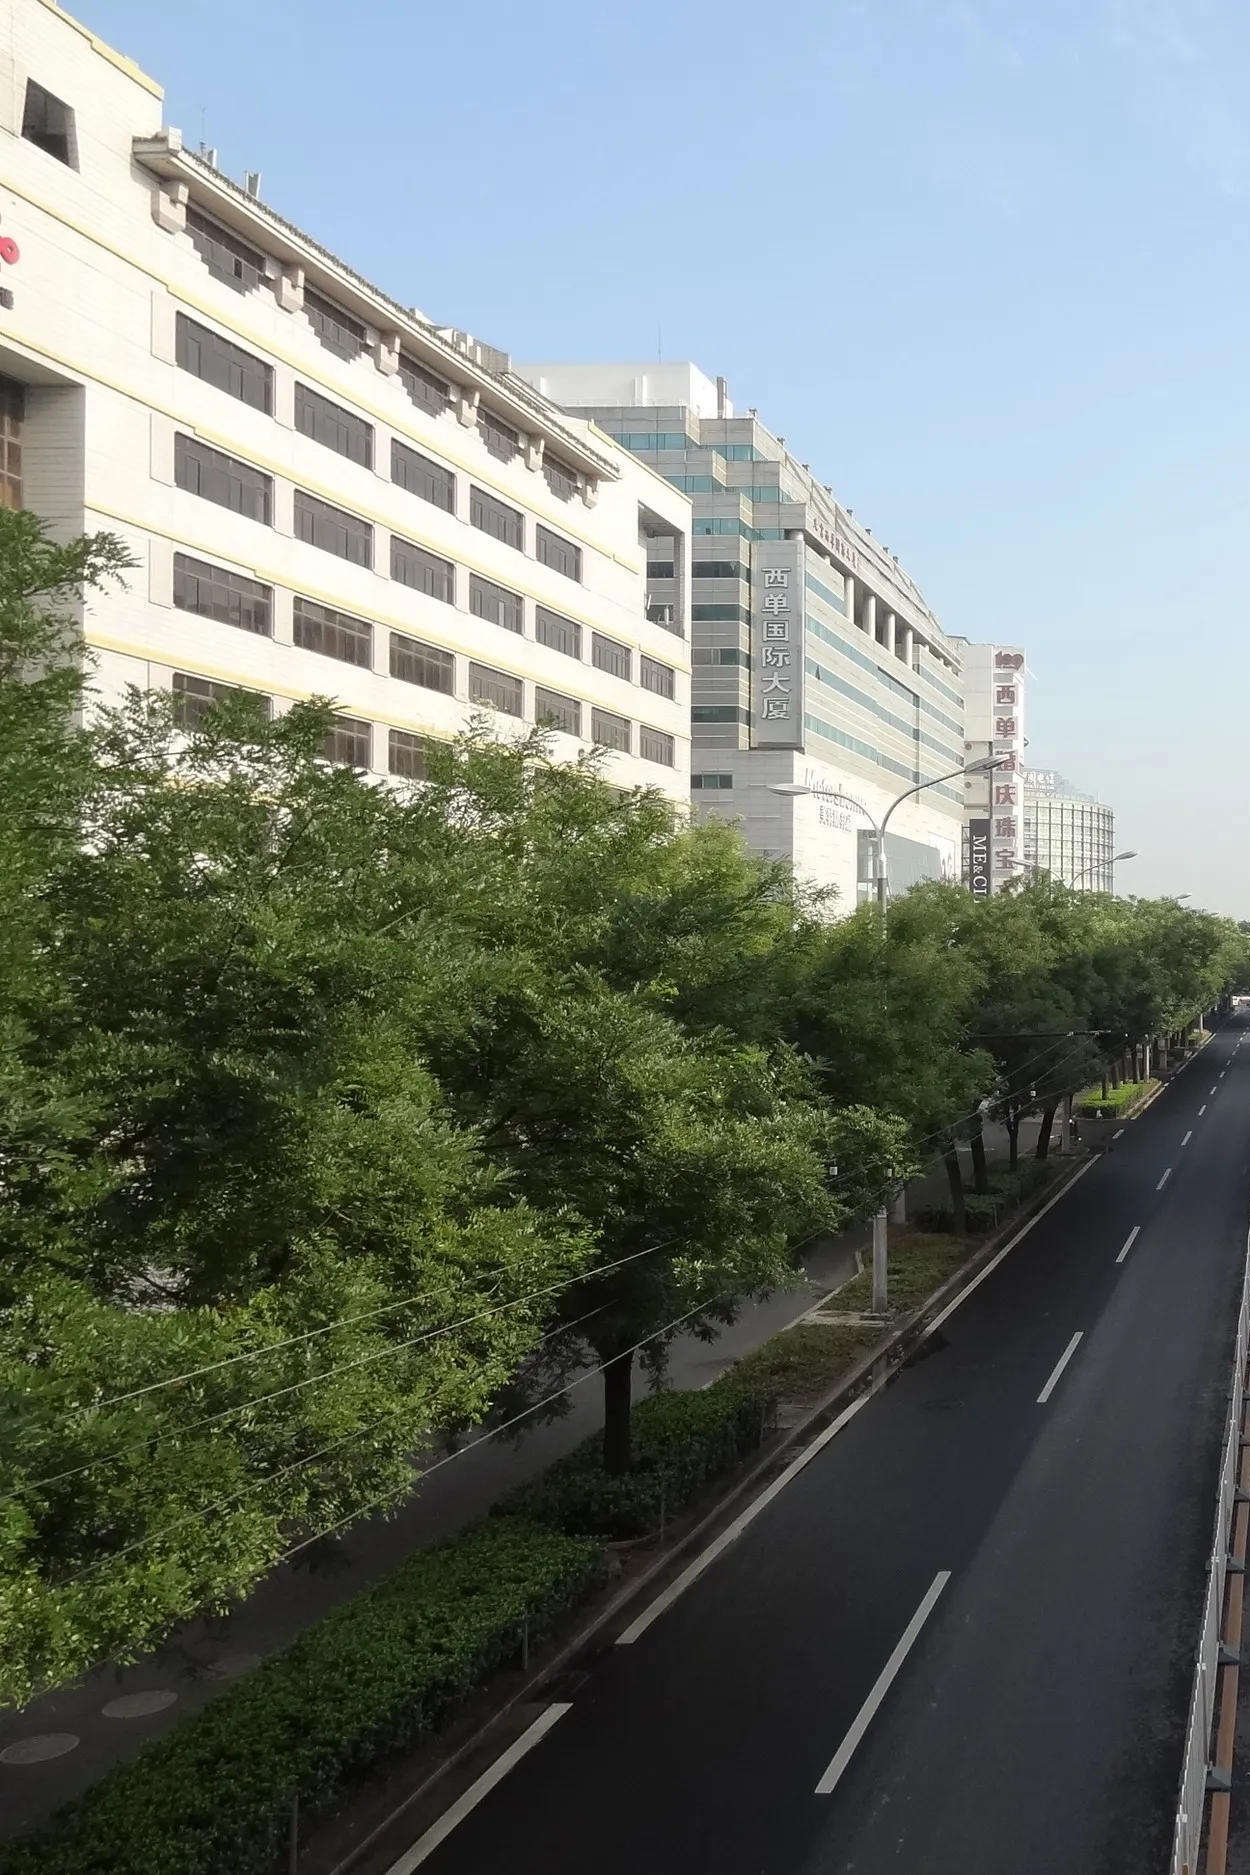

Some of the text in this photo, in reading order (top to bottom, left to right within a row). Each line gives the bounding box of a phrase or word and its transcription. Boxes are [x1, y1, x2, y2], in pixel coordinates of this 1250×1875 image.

[762, 567, 792, 720] 西单国际大厦
